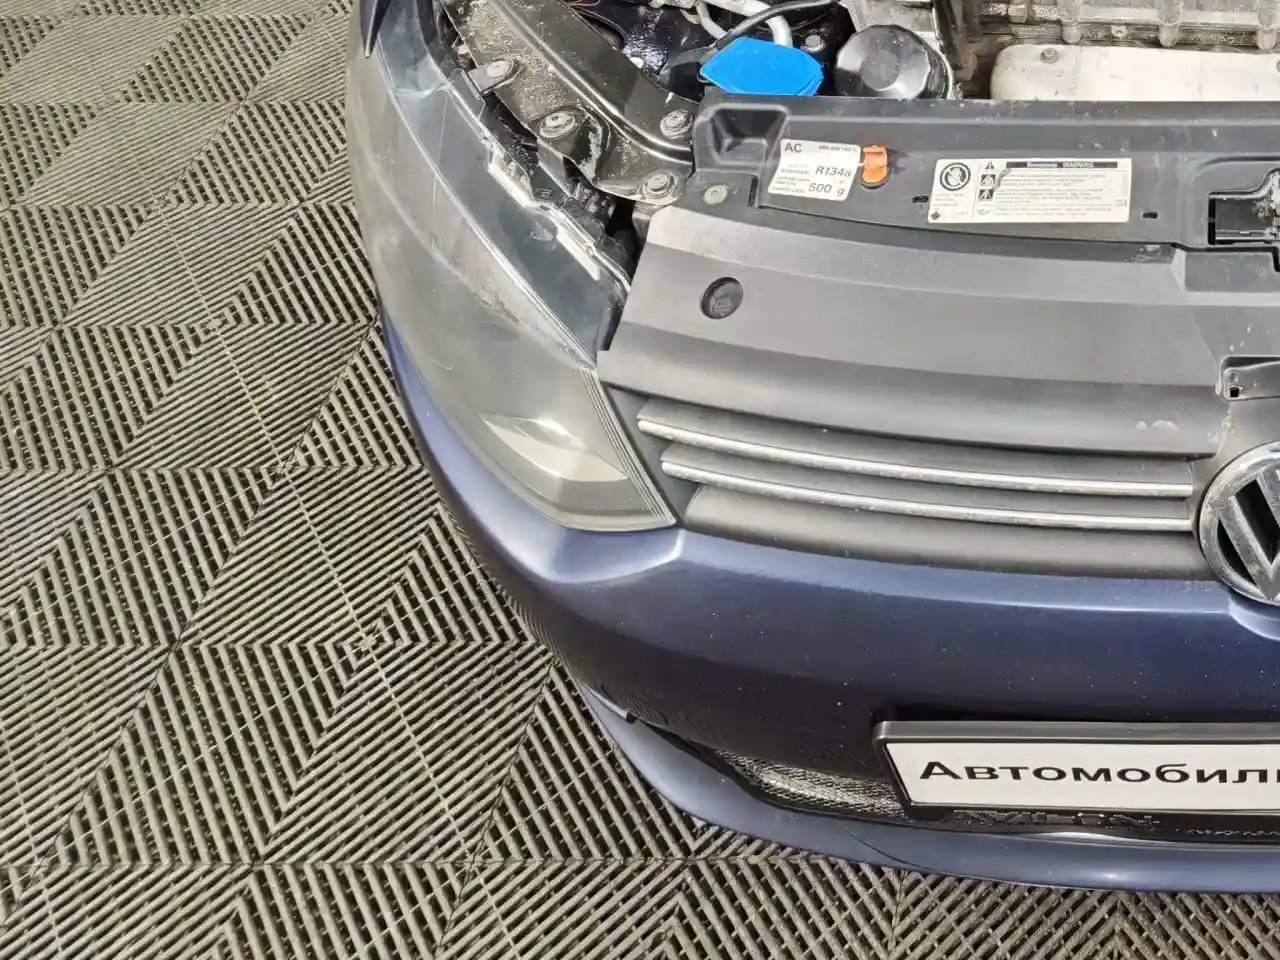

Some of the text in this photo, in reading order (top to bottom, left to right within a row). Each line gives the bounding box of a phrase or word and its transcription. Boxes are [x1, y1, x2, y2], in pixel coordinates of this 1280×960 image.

[784, 143, 802, 153] AC
[815, 165, 852, 178] R134a
[808, 183, 845, 197] 500 g
